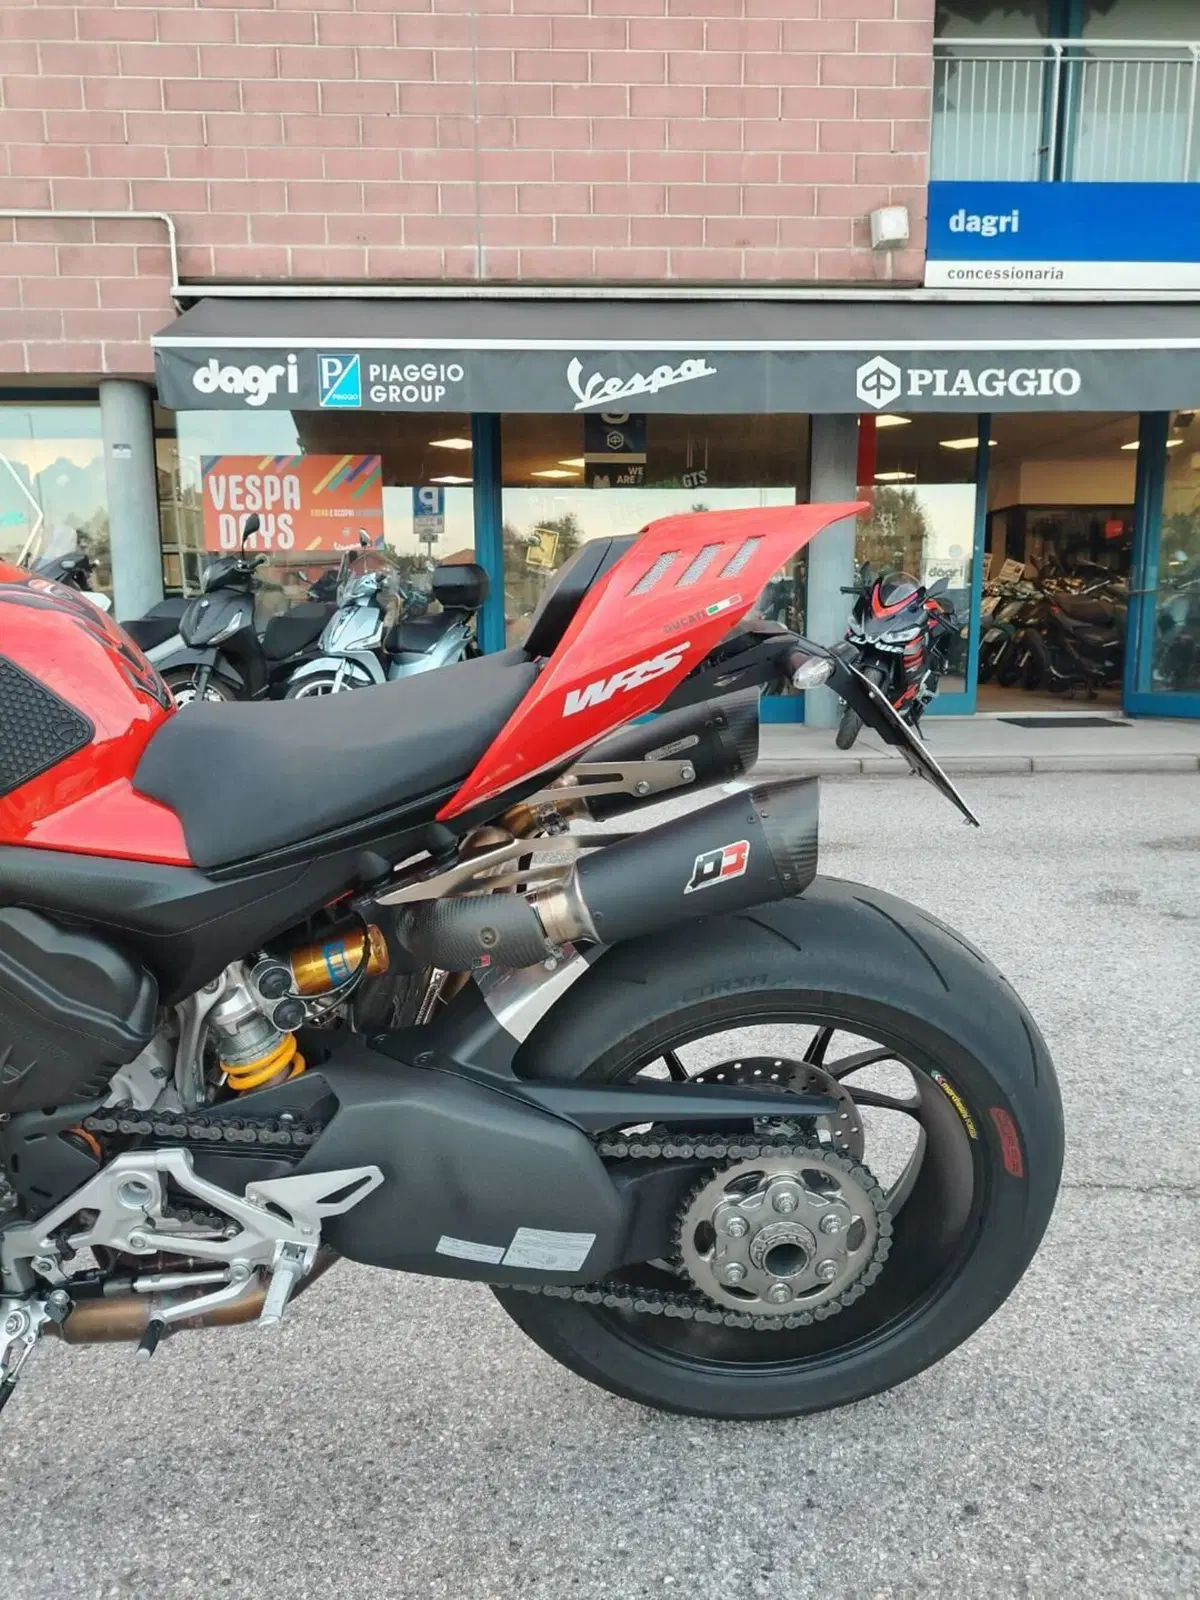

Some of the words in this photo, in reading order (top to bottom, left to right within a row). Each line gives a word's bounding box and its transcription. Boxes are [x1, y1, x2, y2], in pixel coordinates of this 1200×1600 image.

[949, 209, 1020, 237] dagri
[947, 266, 1064, 280] concessionaria
[192, 354, 299, 407] dagri
[369, 364, 464, 383] PIAGGIO
[566, 356, 717, 411] Vespa
[907, 367, 1082, 397] PIAGGIO
[369, 385, 446, 403] GROUP
[616, 475, 635, 485] ARE
[628, 466, 644, 476] WE
[682, 470, 708, 488] GTS
[208, 474, 301, 511] VESPA
[219, 512, 295, 550] DAYS
[663, 611, 707, 634] DUCATI
[563, 641, 691, 718] WRS
